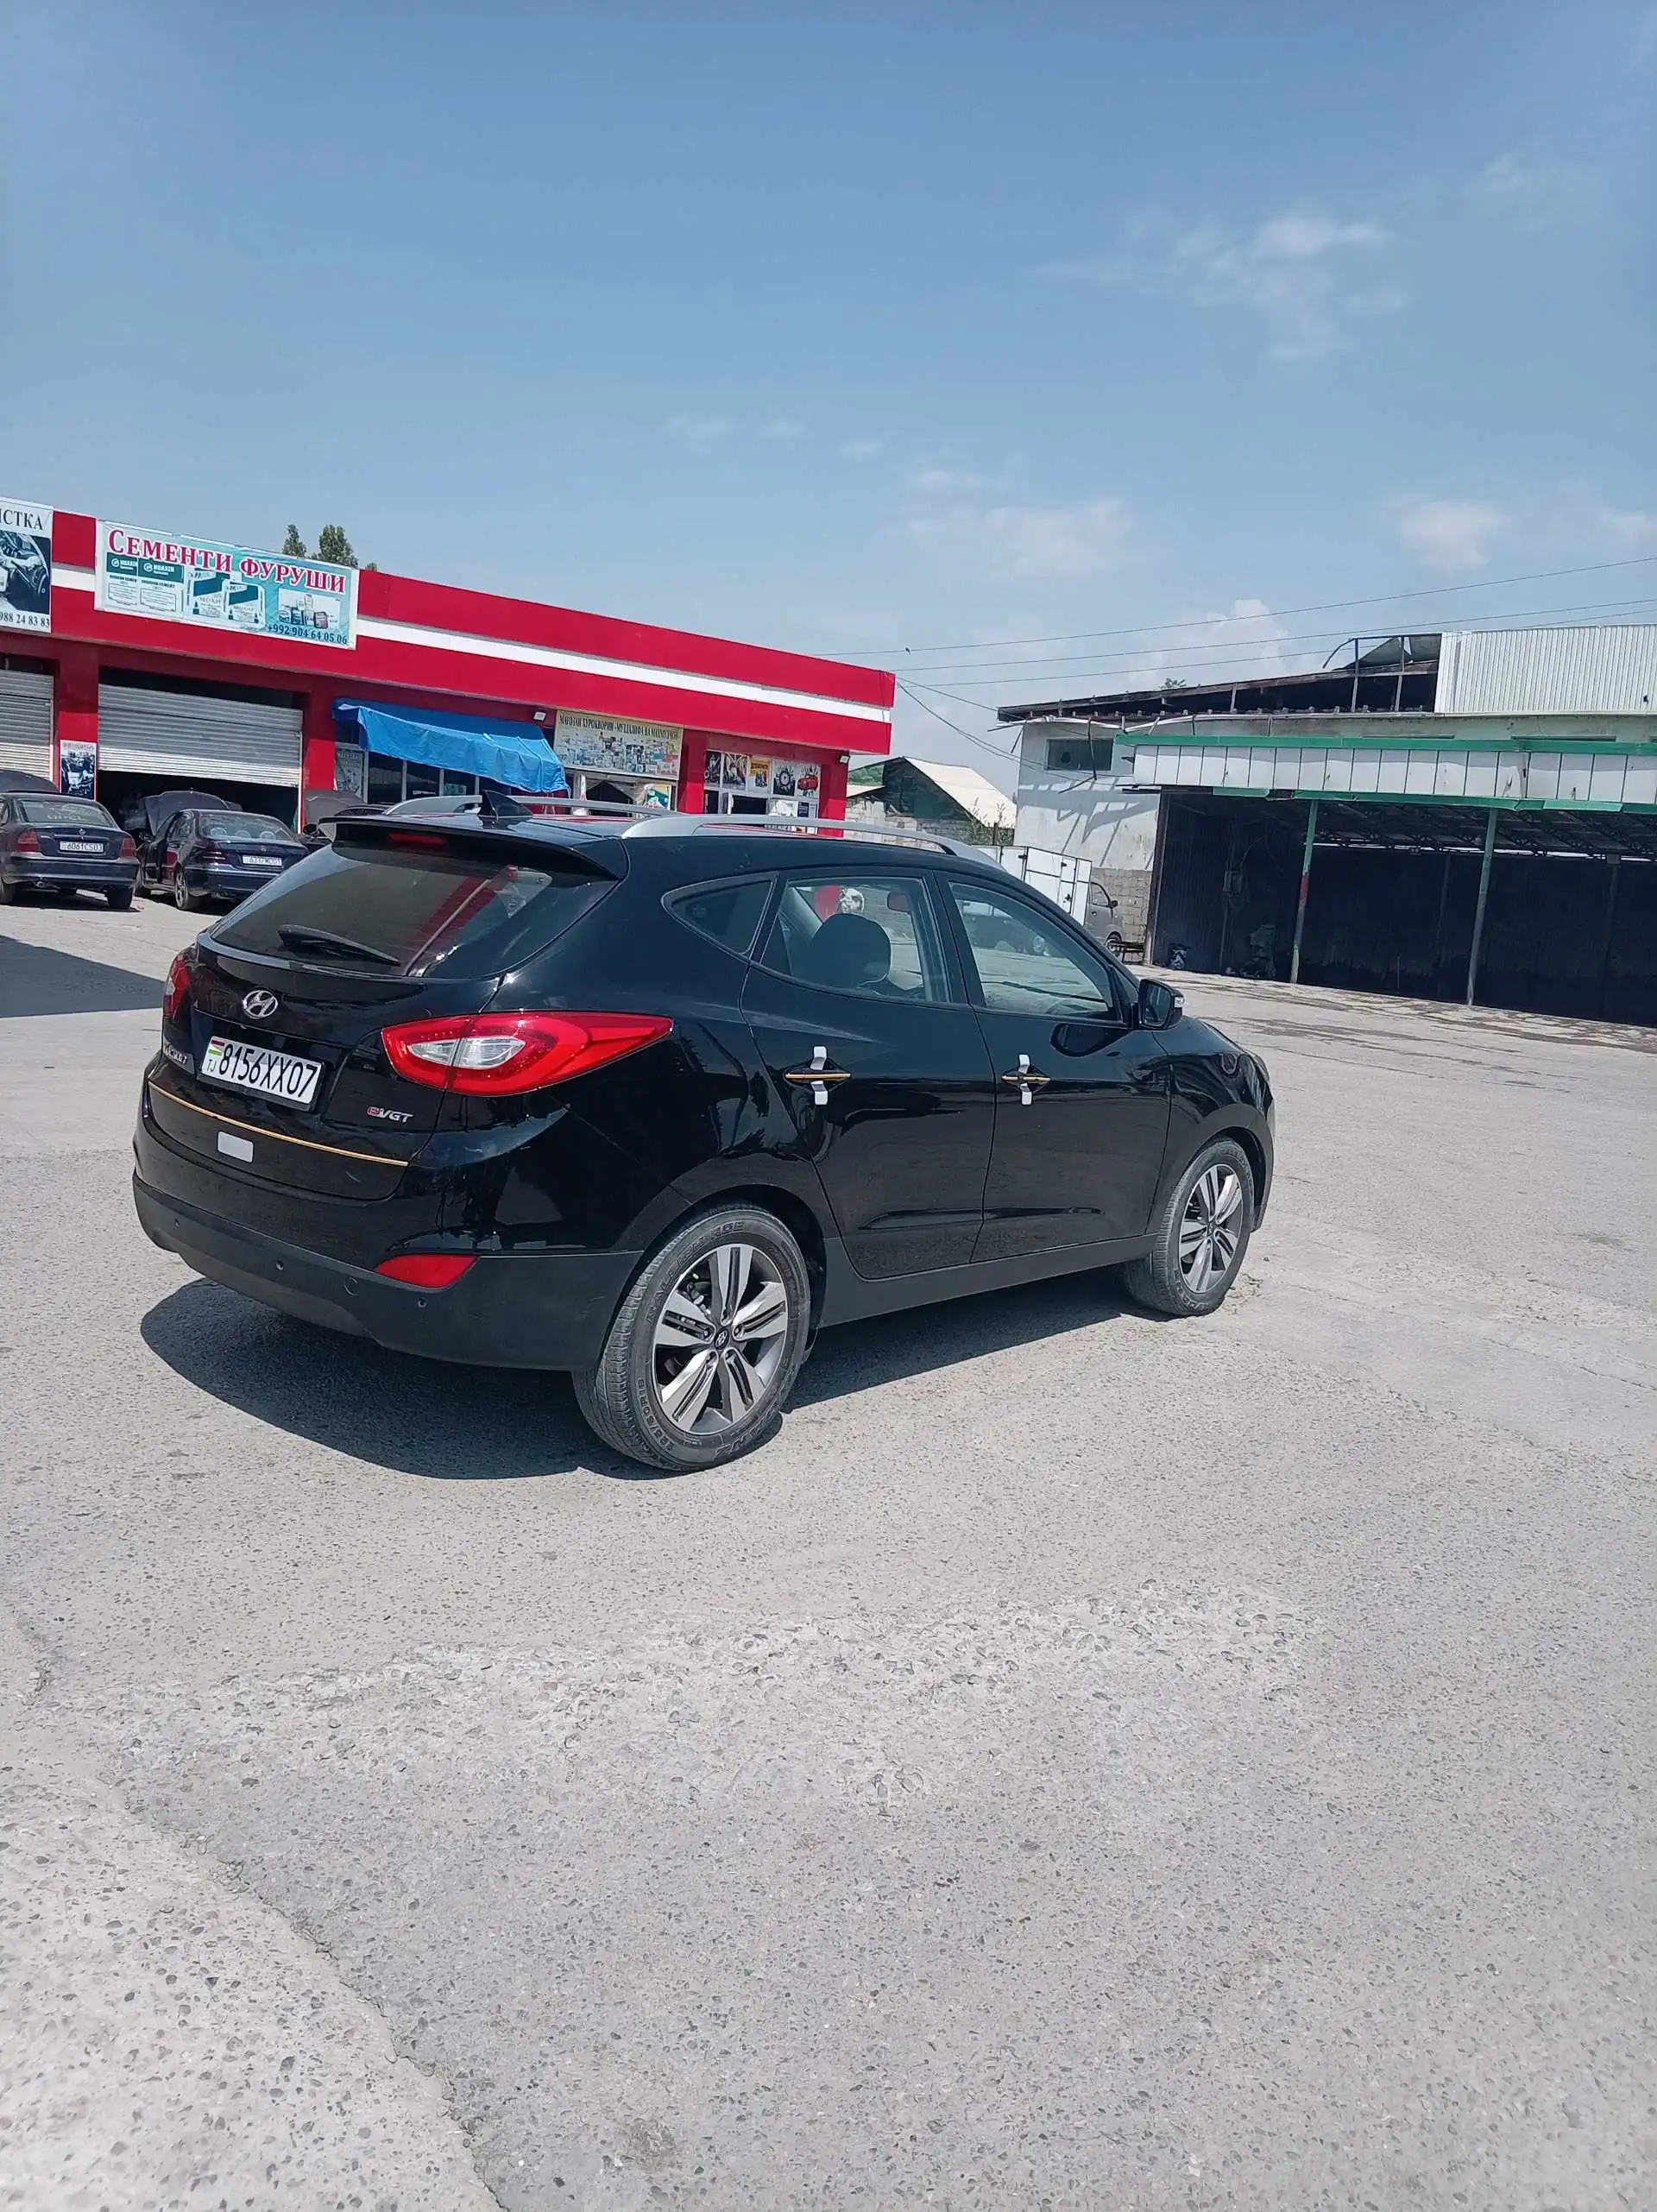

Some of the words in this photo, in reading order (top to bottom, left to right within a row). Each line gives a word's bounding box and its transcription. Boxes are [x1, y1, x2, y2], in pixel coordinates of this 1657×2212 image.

[109, 528, 231, 573] СЕМЕНТИ
[240, 558, 346, 594] ФУРУШИ
[16, 614, 26, 625] 24
[28, 615, 38, 627] 83
[41, 617, 50, 628] 83
[268, 624, 290, 636] +992
[292, 627, 310, 639] 904
[311, 630, 322, 640] 64
[324, 632, 335, 642] 05
[337, 634, 348, 645] 06
[218, 1043, 320, 1099] 8156XX07
